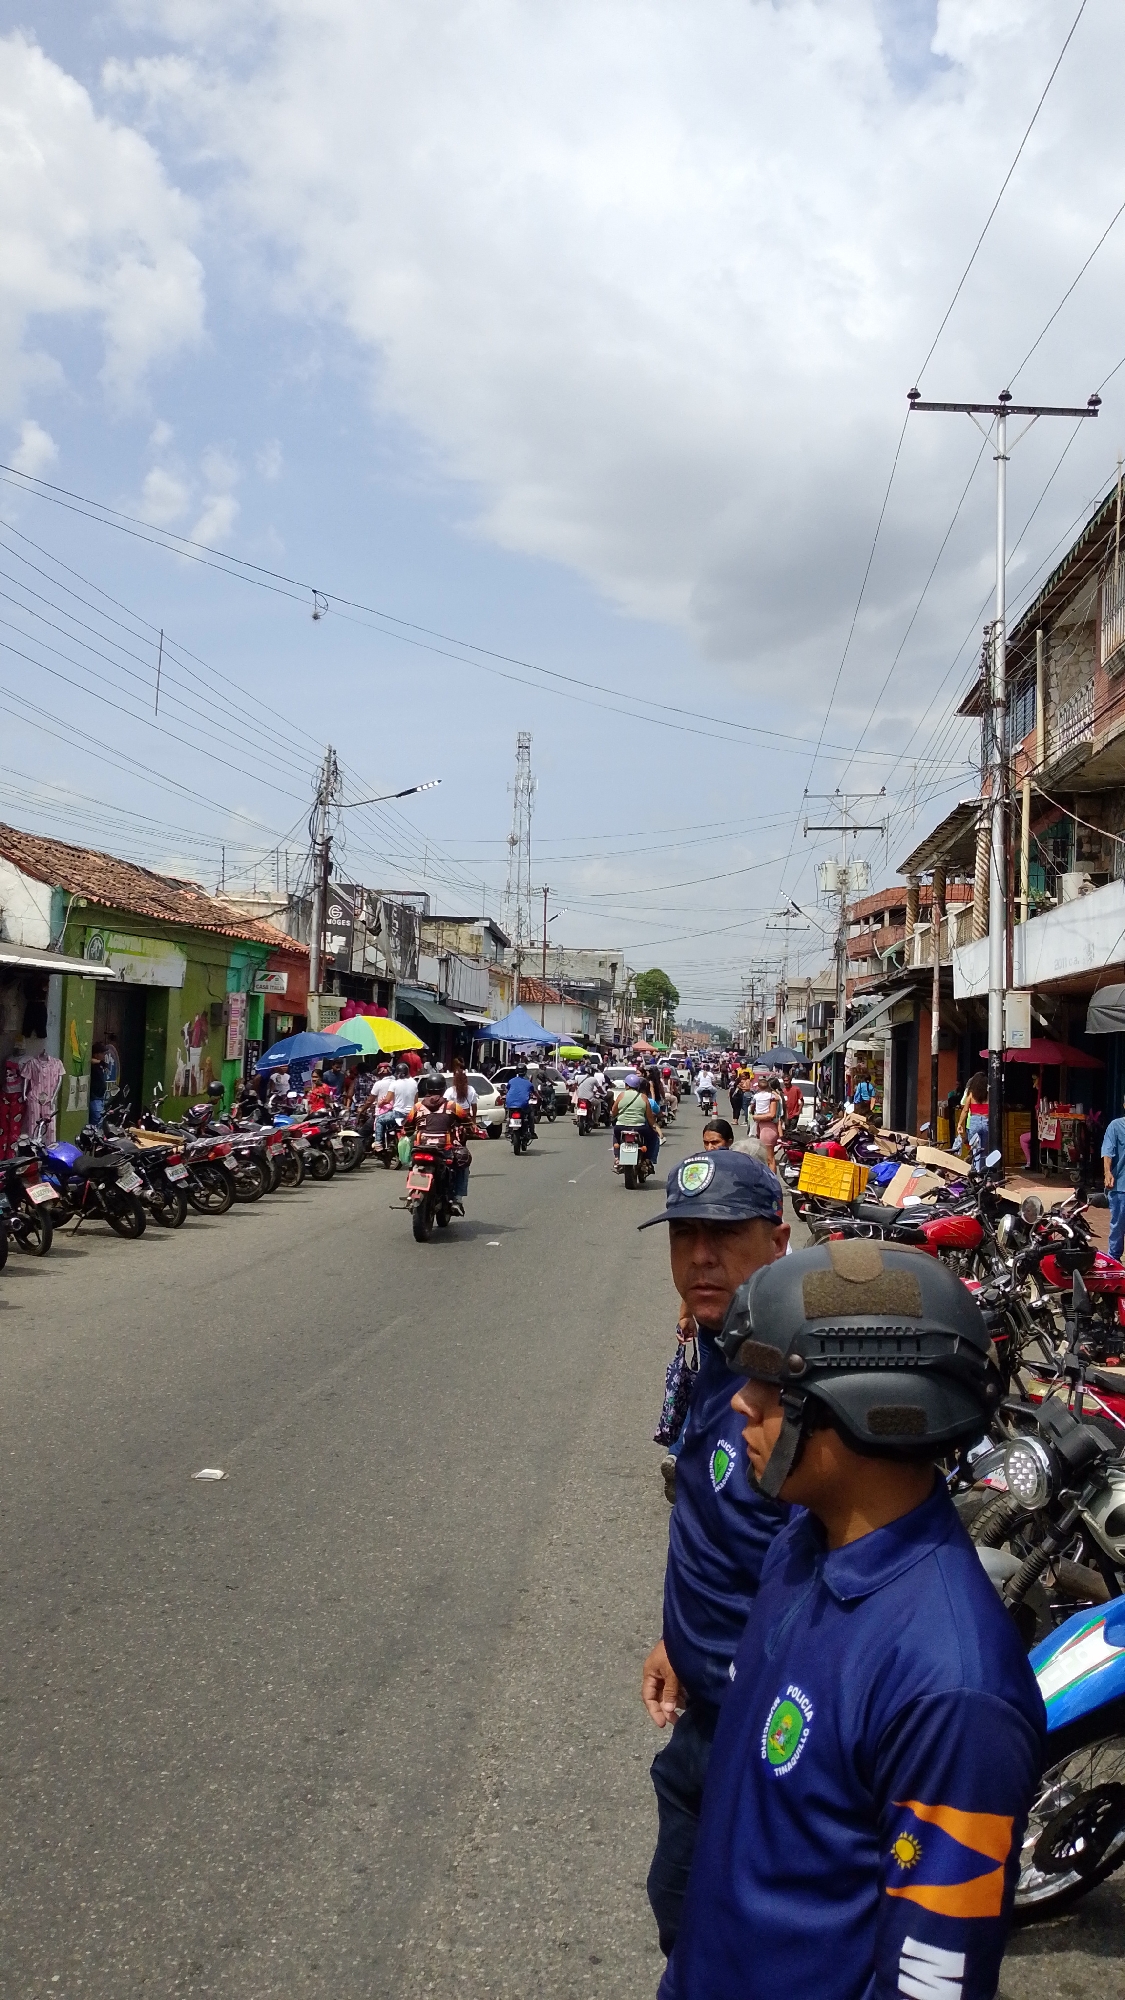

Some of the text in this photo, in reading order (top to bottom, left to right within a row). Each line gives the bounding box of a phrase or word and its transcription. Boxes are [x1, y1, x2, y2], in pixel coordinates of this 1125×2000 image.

[761, 1696, 781, 1759] MUNICIPIO
[786, 1684, 814, 1722] POLICÍA
[773, 1727, 810, 1777] TINAQUILLO
